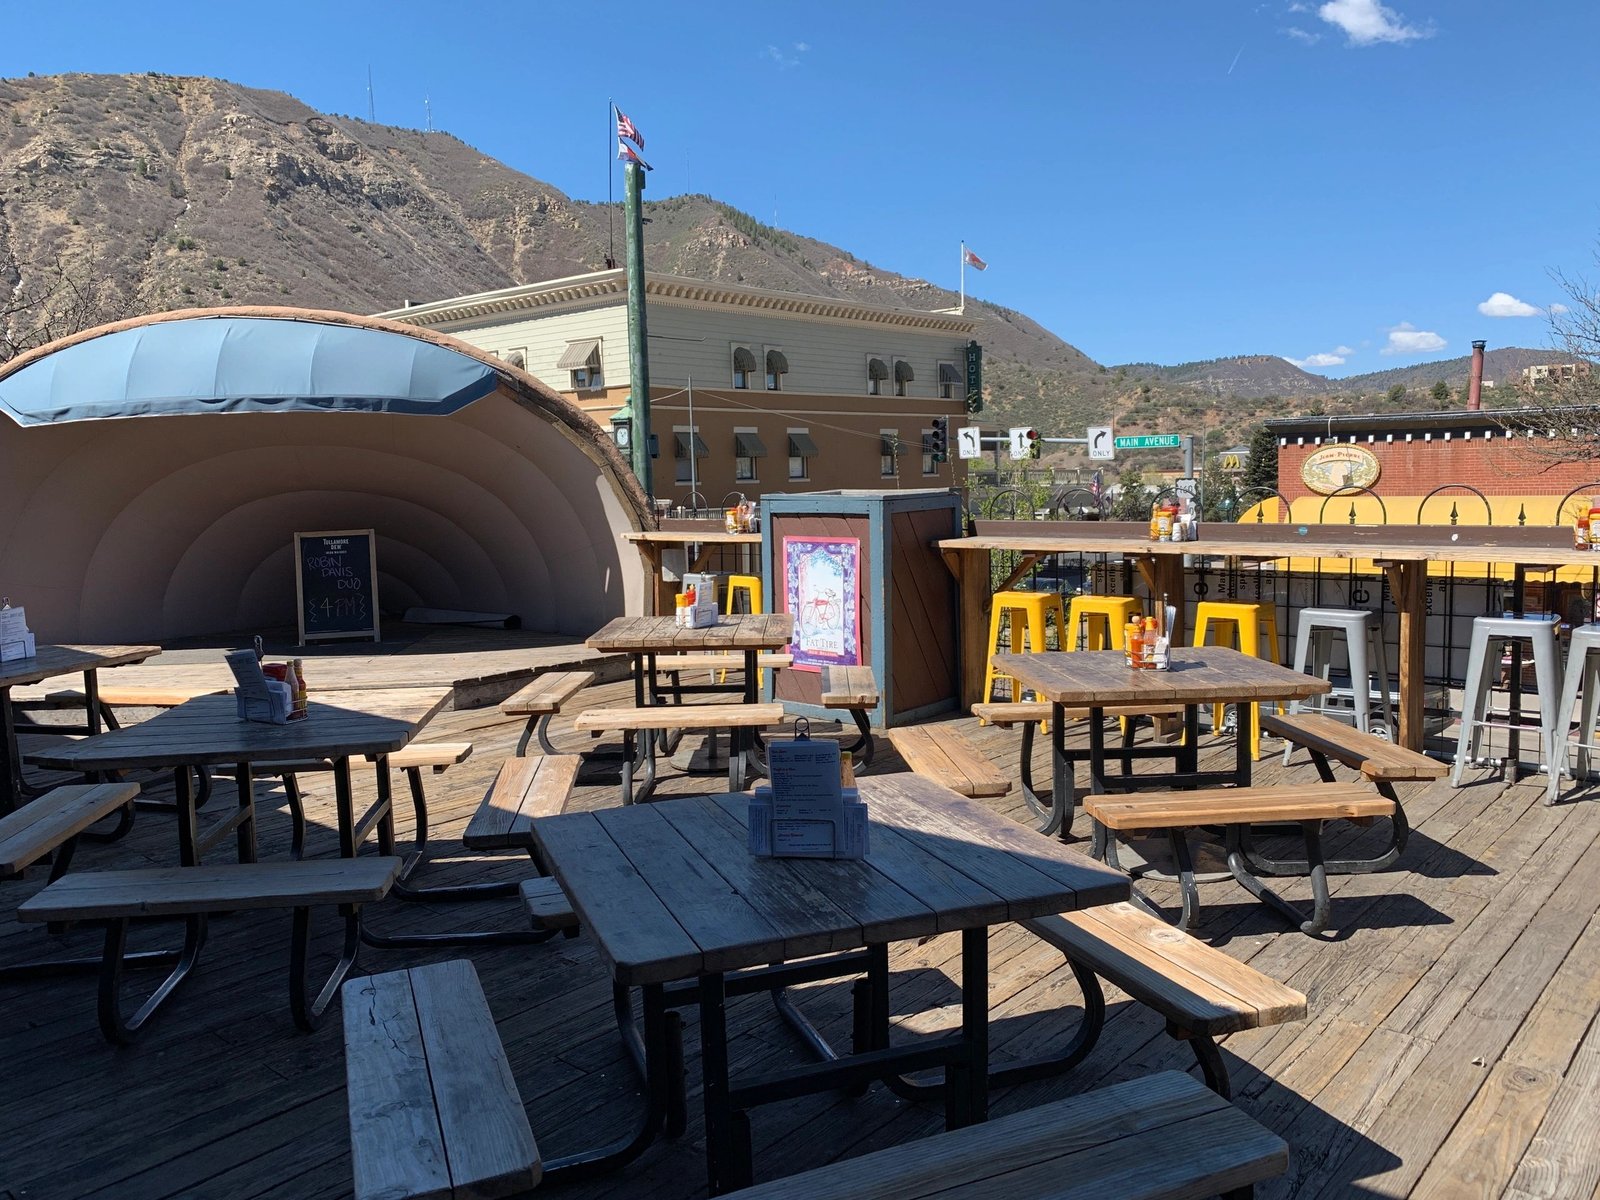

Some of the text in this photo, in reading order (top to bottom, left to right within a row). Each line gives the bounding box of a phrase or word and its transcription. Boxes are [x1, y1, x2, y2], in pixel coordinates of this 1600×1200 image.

[1119, 436, 1175, 447] MAIN AVENUE
[307, 555, 342, 571] ROBIN
[321, 566, 354, 578] DAVIS
[338, 578, 362, 590] DUO
